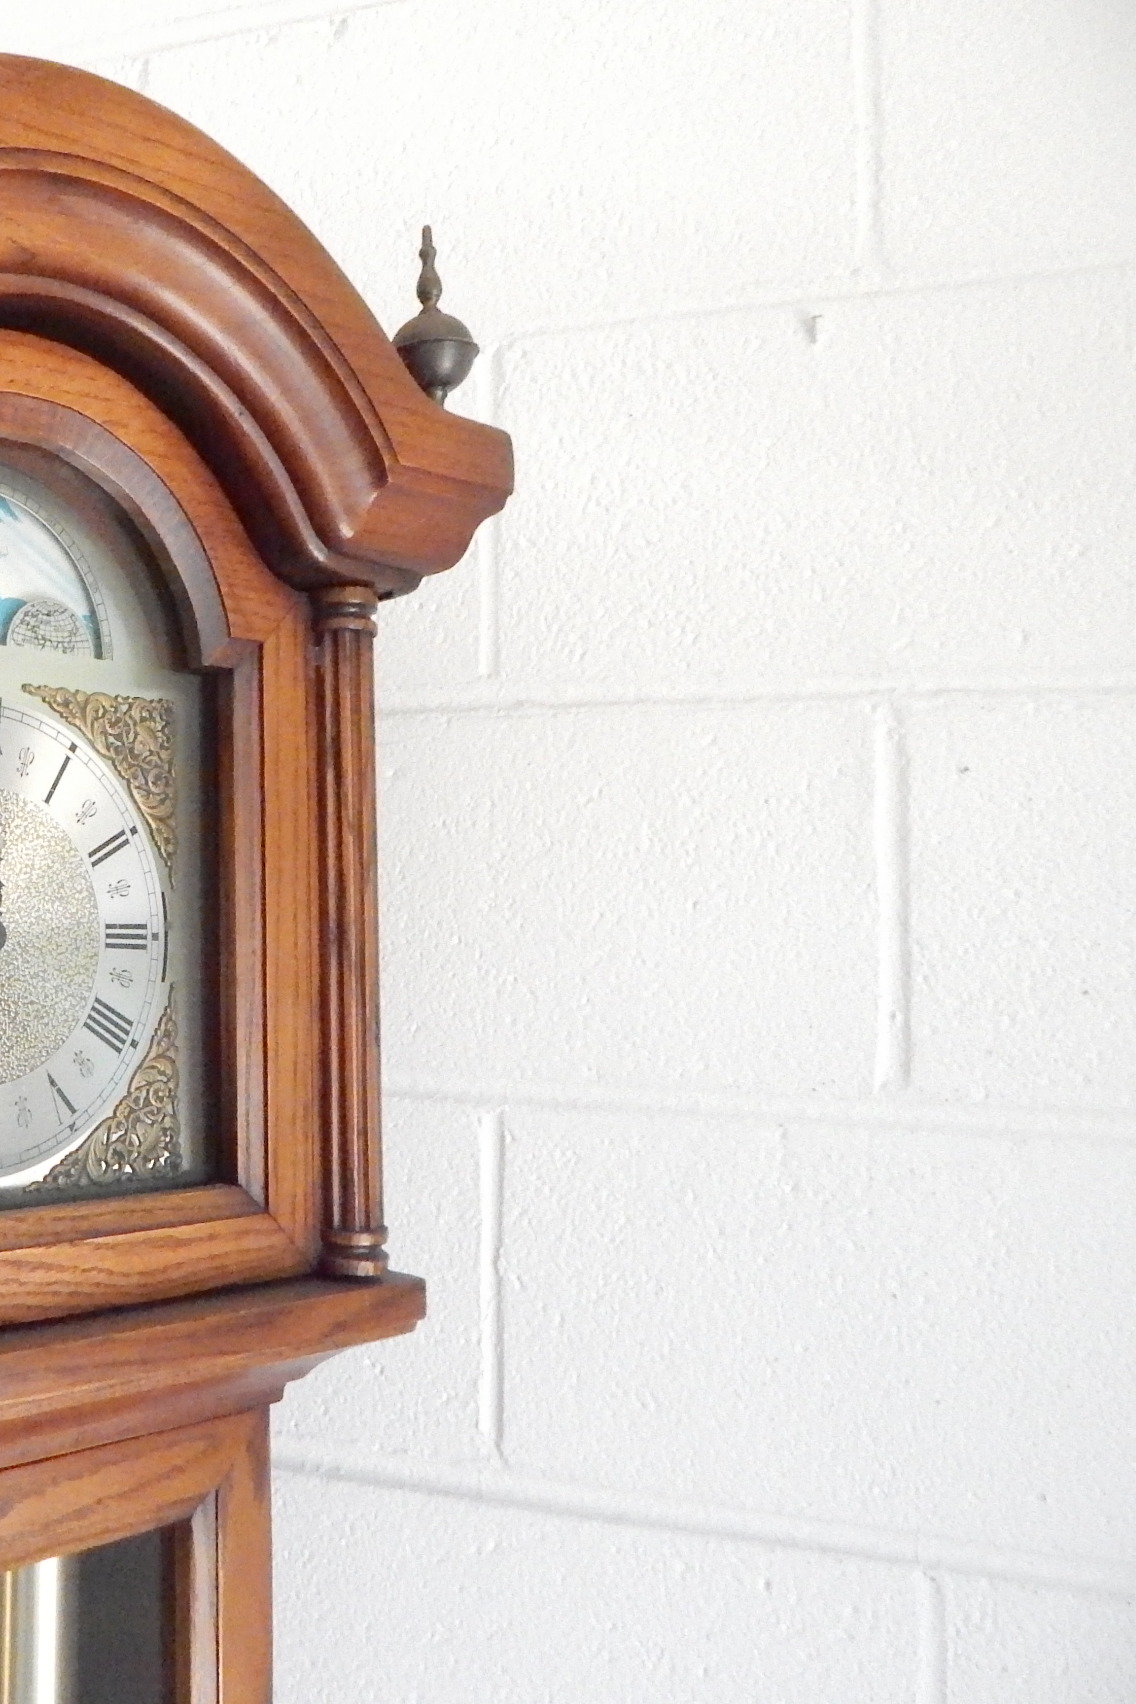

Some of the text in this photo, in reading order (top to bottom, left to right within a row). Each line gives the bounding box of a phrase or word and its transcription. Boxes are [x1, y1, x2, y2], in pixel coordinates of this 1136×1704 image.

[42, 753, 74, 806] I
[87, 826, 131, 872] II
[105, 919, 148, 954] III
[81, 992, 137, 1058] IIII
[45, 1068, 80, 1126] V
